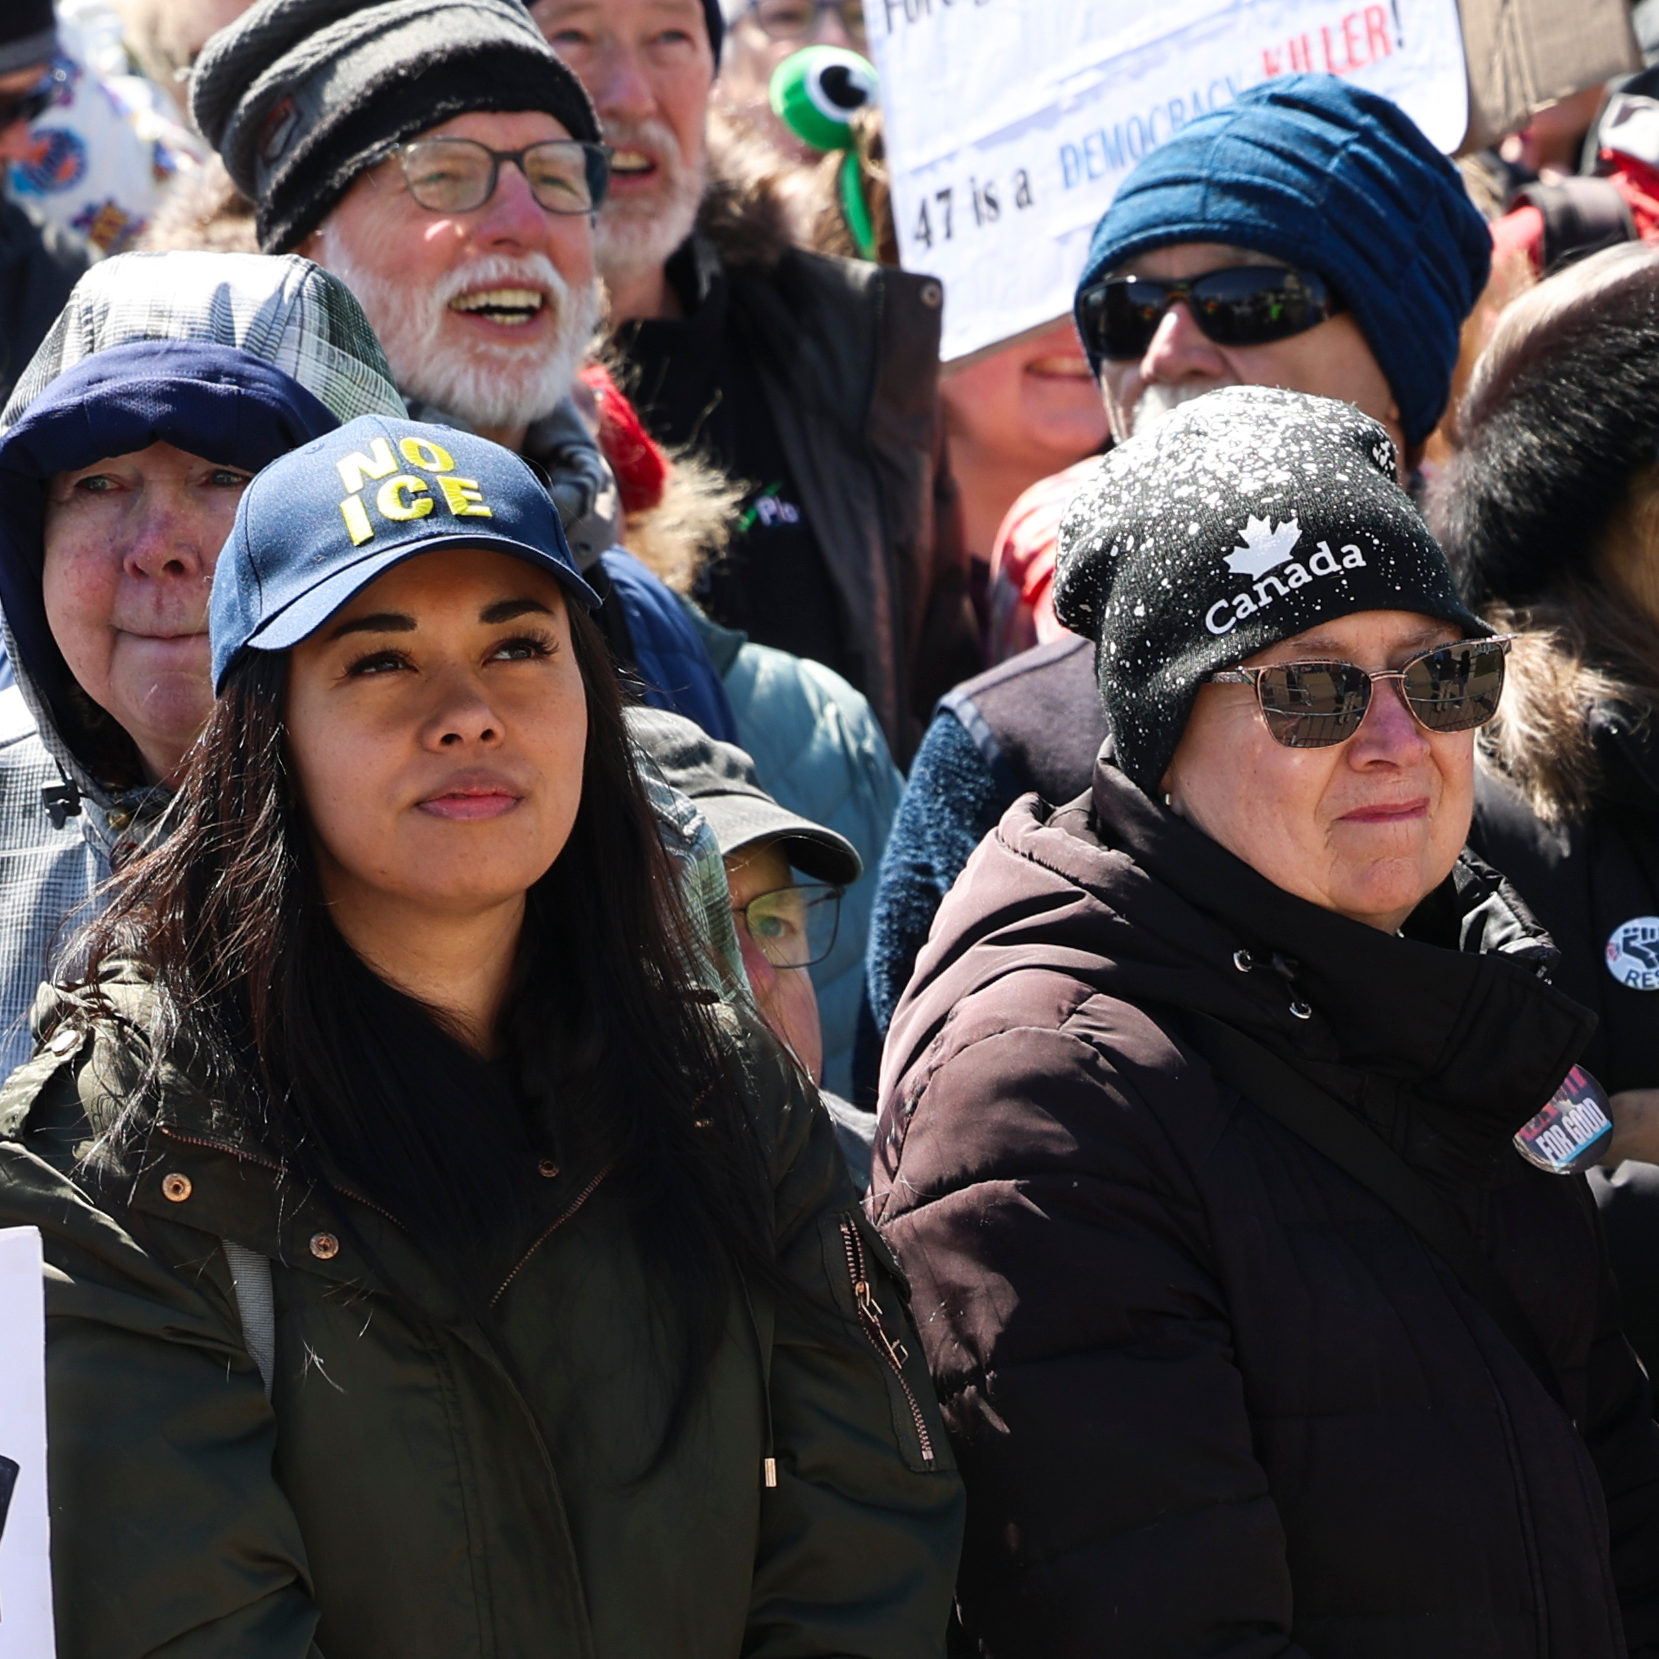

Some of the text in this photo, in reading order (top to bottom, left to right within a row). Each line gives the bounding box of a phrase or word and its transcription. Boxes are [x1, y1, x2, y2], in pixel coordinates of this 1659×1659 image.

[914, 187, 953, 249] 47
[970, 176, 1001, 227] is
[1015, 168, 1034, 210] a
[336, 436, 456, 494] NO
[339, 475, 493, 547] ICE
[1205, 540, 1367, 635] Canada
[1535, 1124, 1577, 1166] FOR
[1562, 1097, 1609, 1146] GOOD
